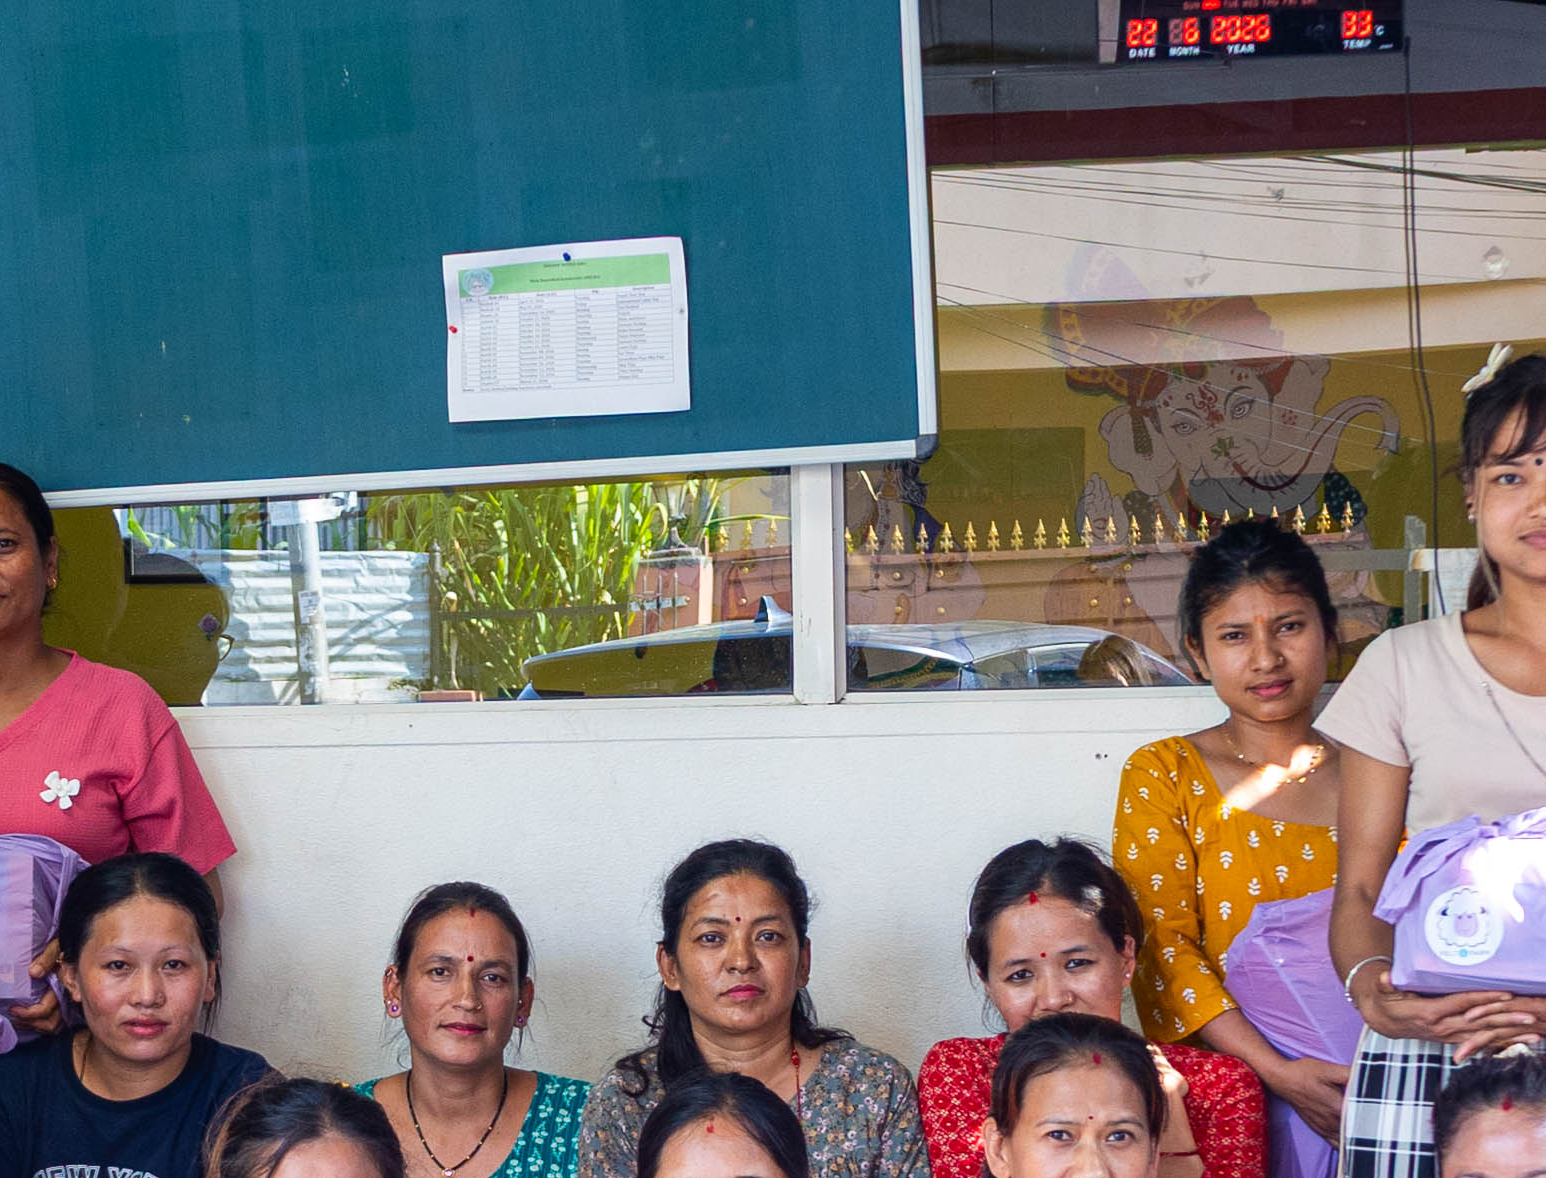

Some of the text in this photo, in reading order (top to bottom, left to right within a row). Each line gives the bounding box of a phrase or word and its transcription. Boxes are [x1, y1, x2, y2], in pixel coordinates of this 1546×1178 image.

[1127, 18, 1157, 47] 22
[1211, 14, 1271, 43] 2026
[1342, 10, 1373, 38] 33
[1129, 39, 1371, 58] DATE MONTH YEAR TEMP
